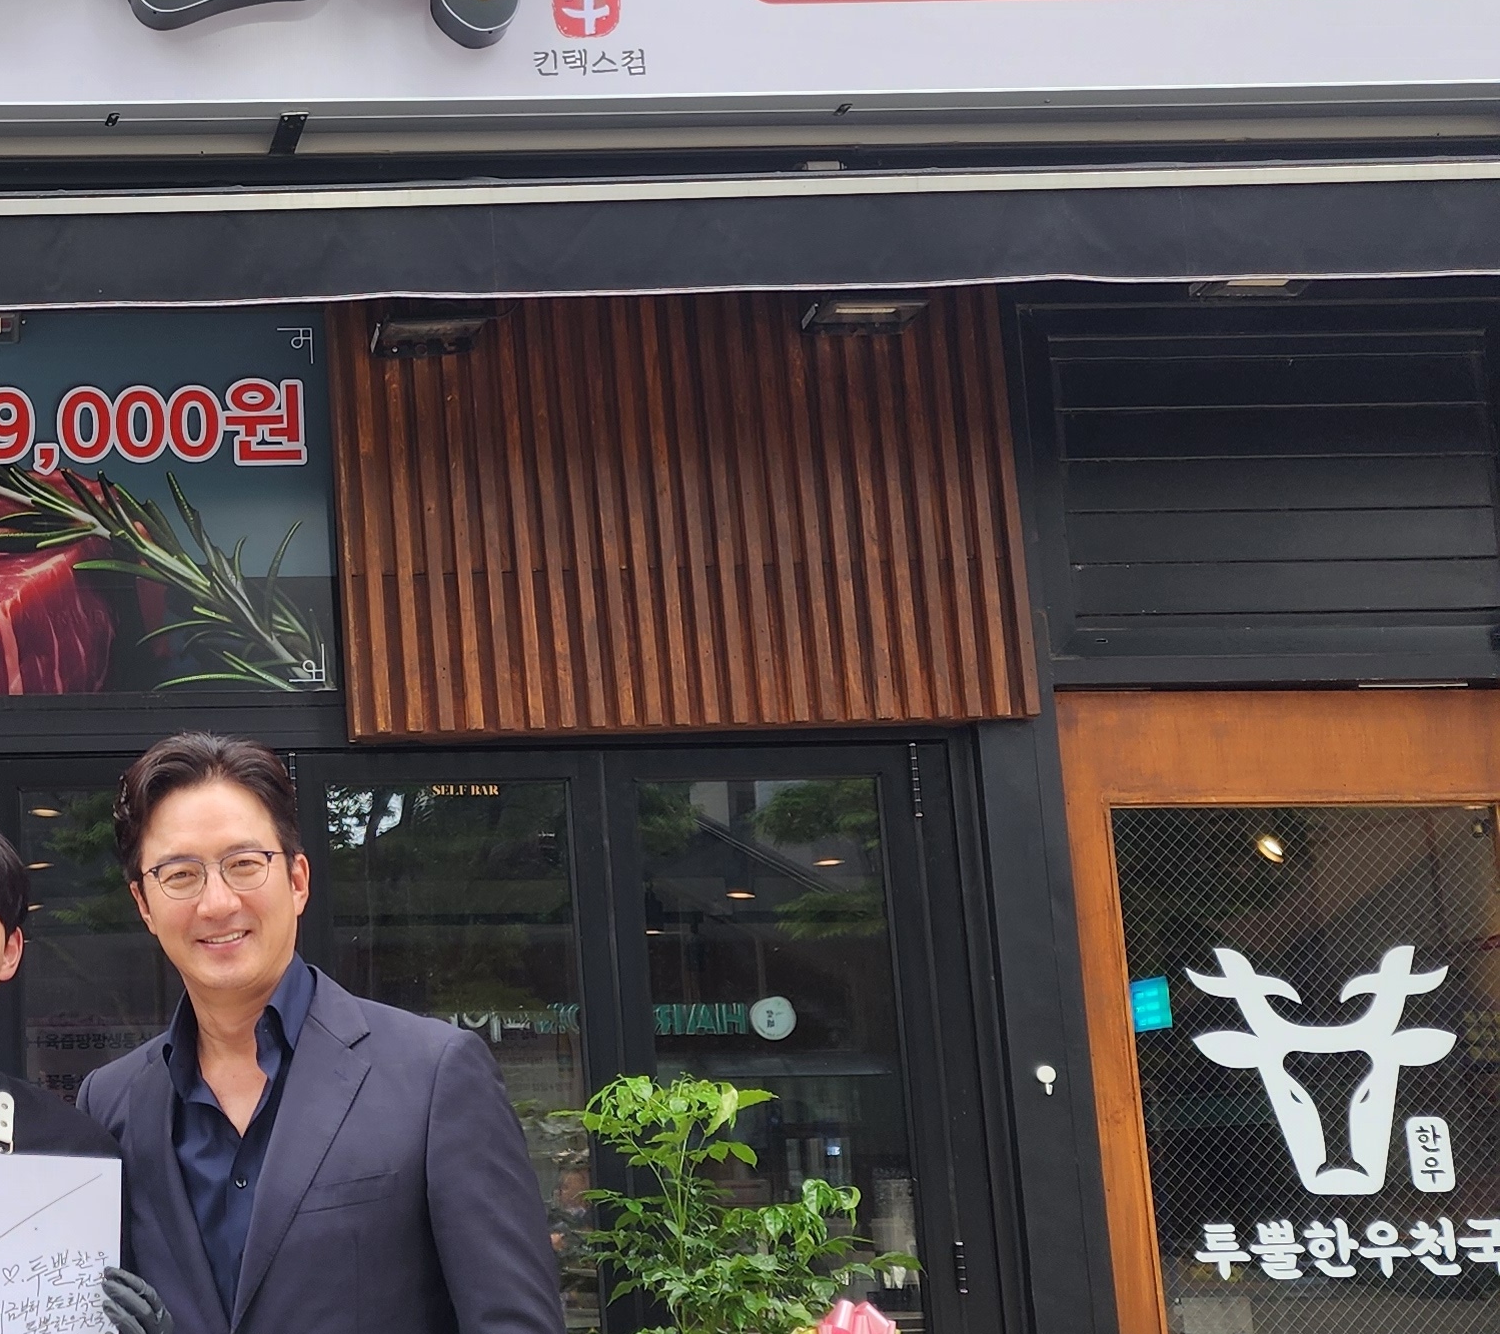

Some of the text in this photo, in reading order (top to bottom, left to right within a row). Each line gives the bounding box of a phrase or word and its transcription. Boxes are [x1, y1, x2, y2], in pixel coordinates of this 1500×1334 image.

[533, 48, 647, 76] 킨텍스점
[431, 783, 500, 796] SELF BAR
[1415, 1124, 1445, 1184] 한우
[1194, 1216, 1500, 1280] 투뿔한우천국
